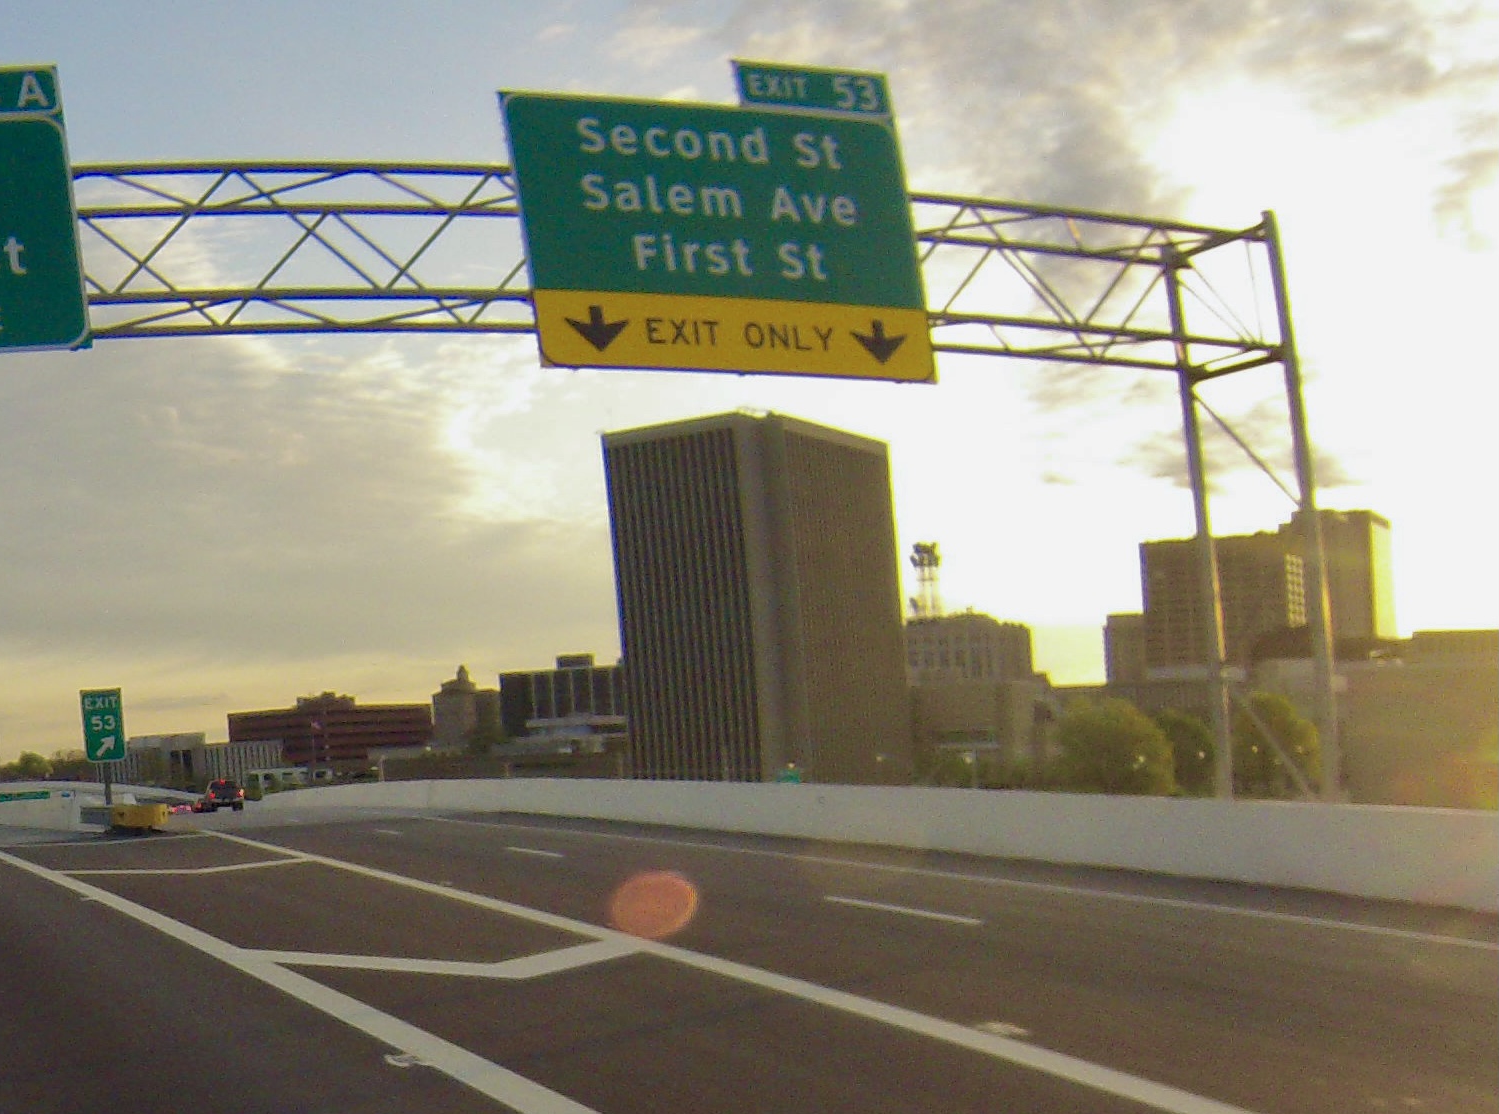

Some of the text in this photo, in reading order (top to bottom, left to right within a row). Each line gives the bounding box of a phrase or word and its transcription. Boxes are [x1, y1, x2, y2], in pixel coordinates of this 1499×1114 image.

[17, 71, 49, 108] A
[747, 73, 878, 111] EXIT 53
[576, 118, 842, 170] Second St
[581, 174, 857, 226] Salem Ave
[632, 233, 827, 281] First St
[645, 318, 834, 352] EXIT ONLY
[84, 696, 118, 709] EXIT
[91, 715, 116, 731] 53
